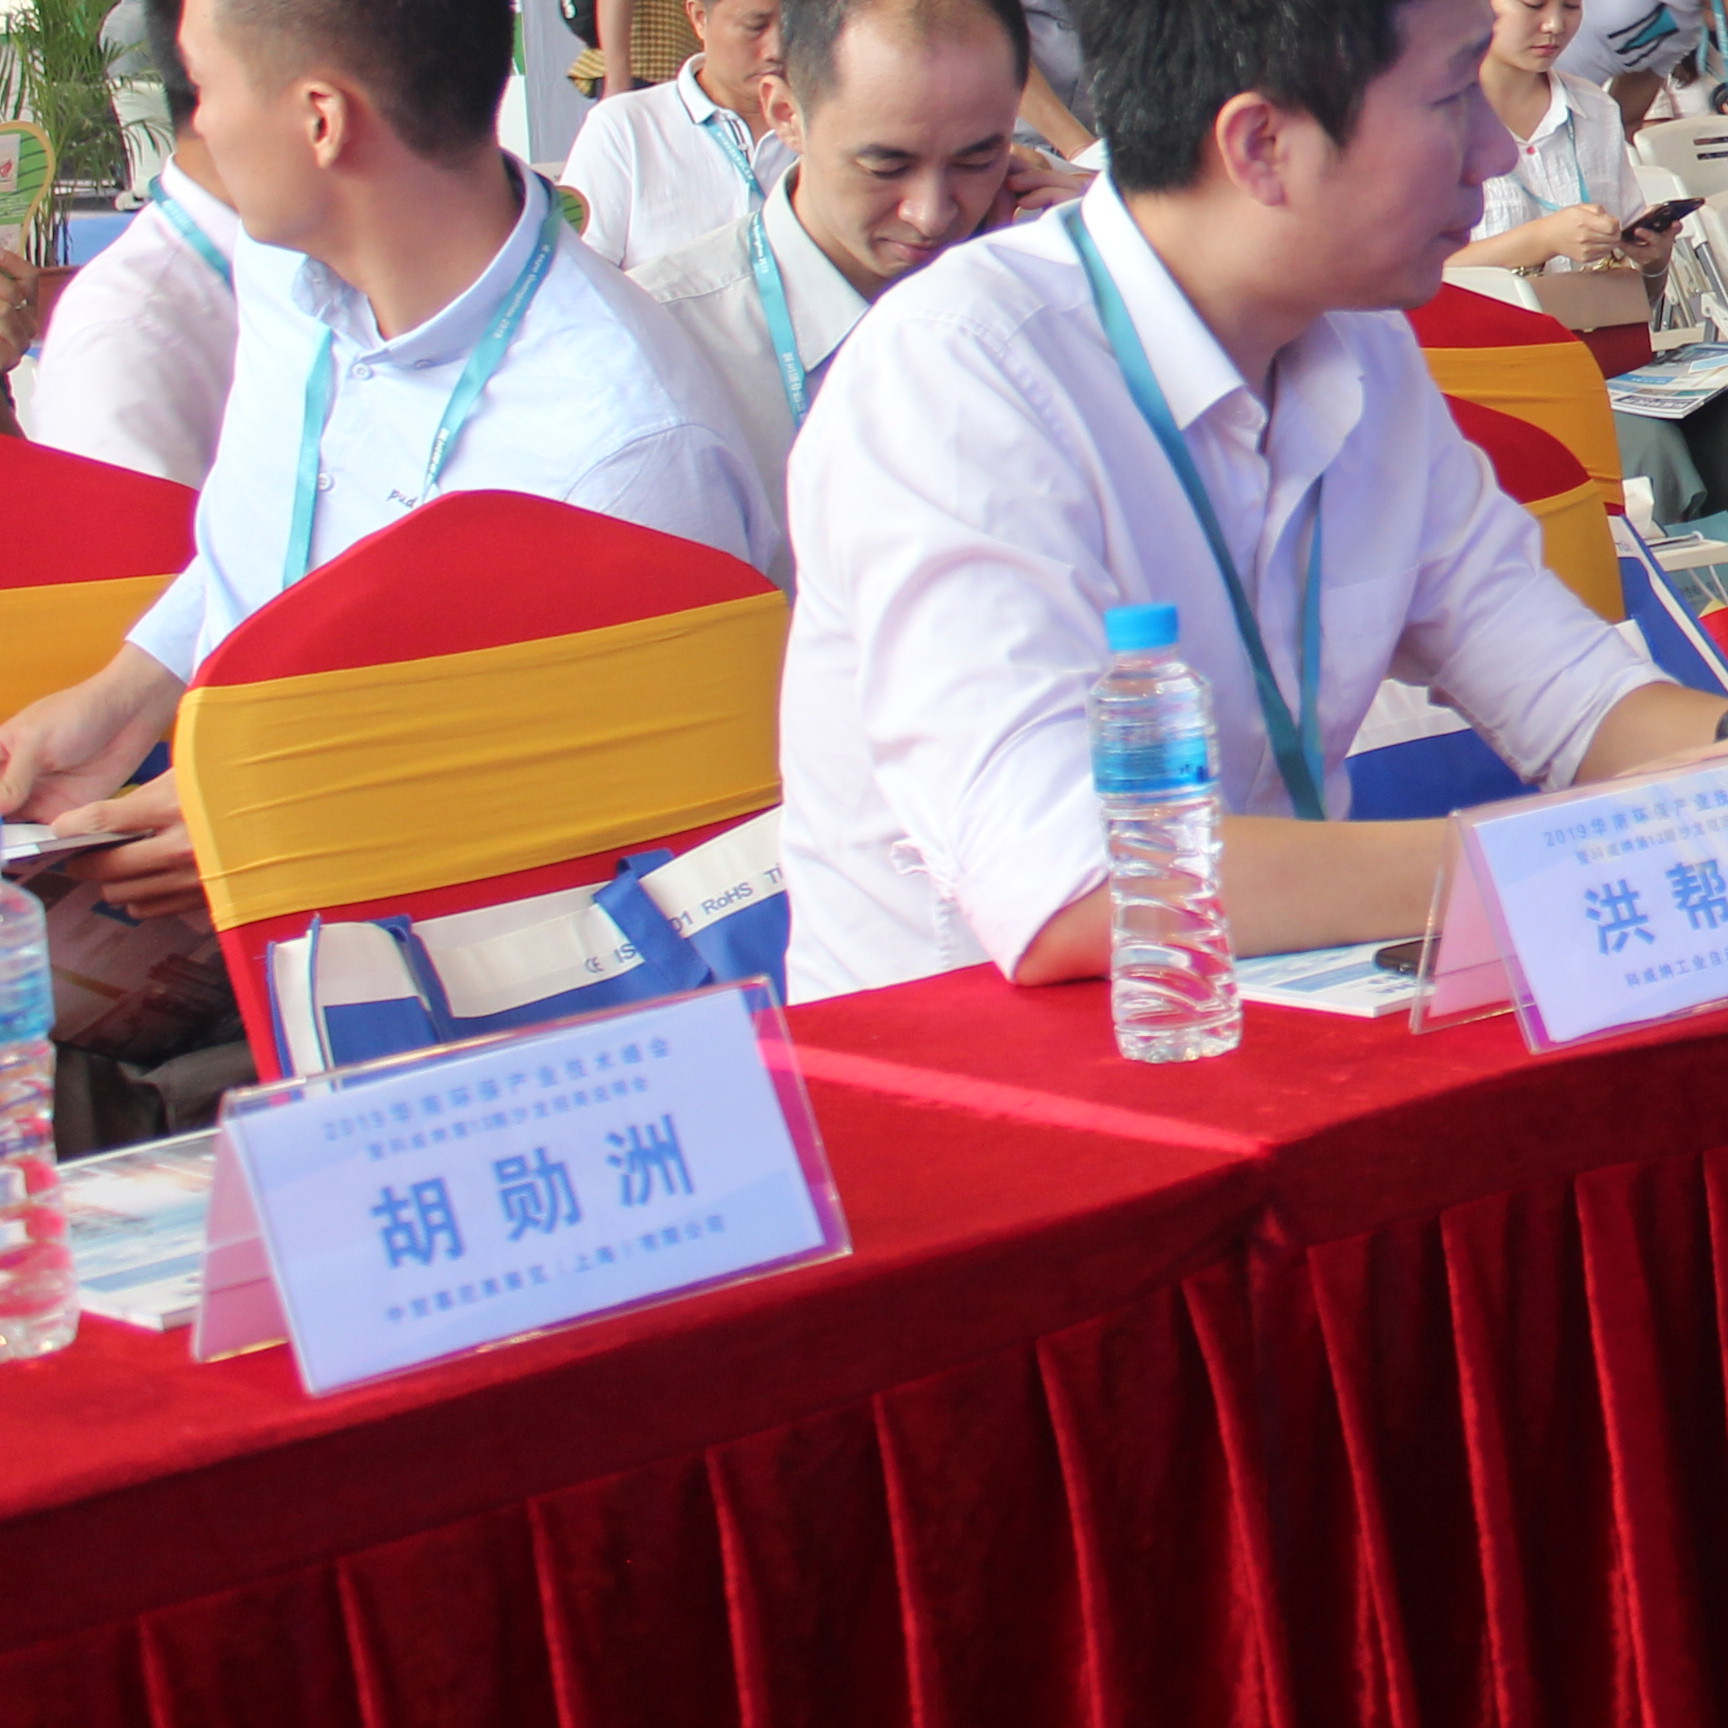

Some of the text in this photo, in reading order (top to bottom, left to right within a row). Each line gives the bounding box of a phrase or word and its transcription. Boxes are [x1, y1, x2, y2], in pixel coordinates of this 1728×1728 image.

[701, 881, 754, 916] RoHS
[369, 1113, 697, 1270] 胡勋洲
